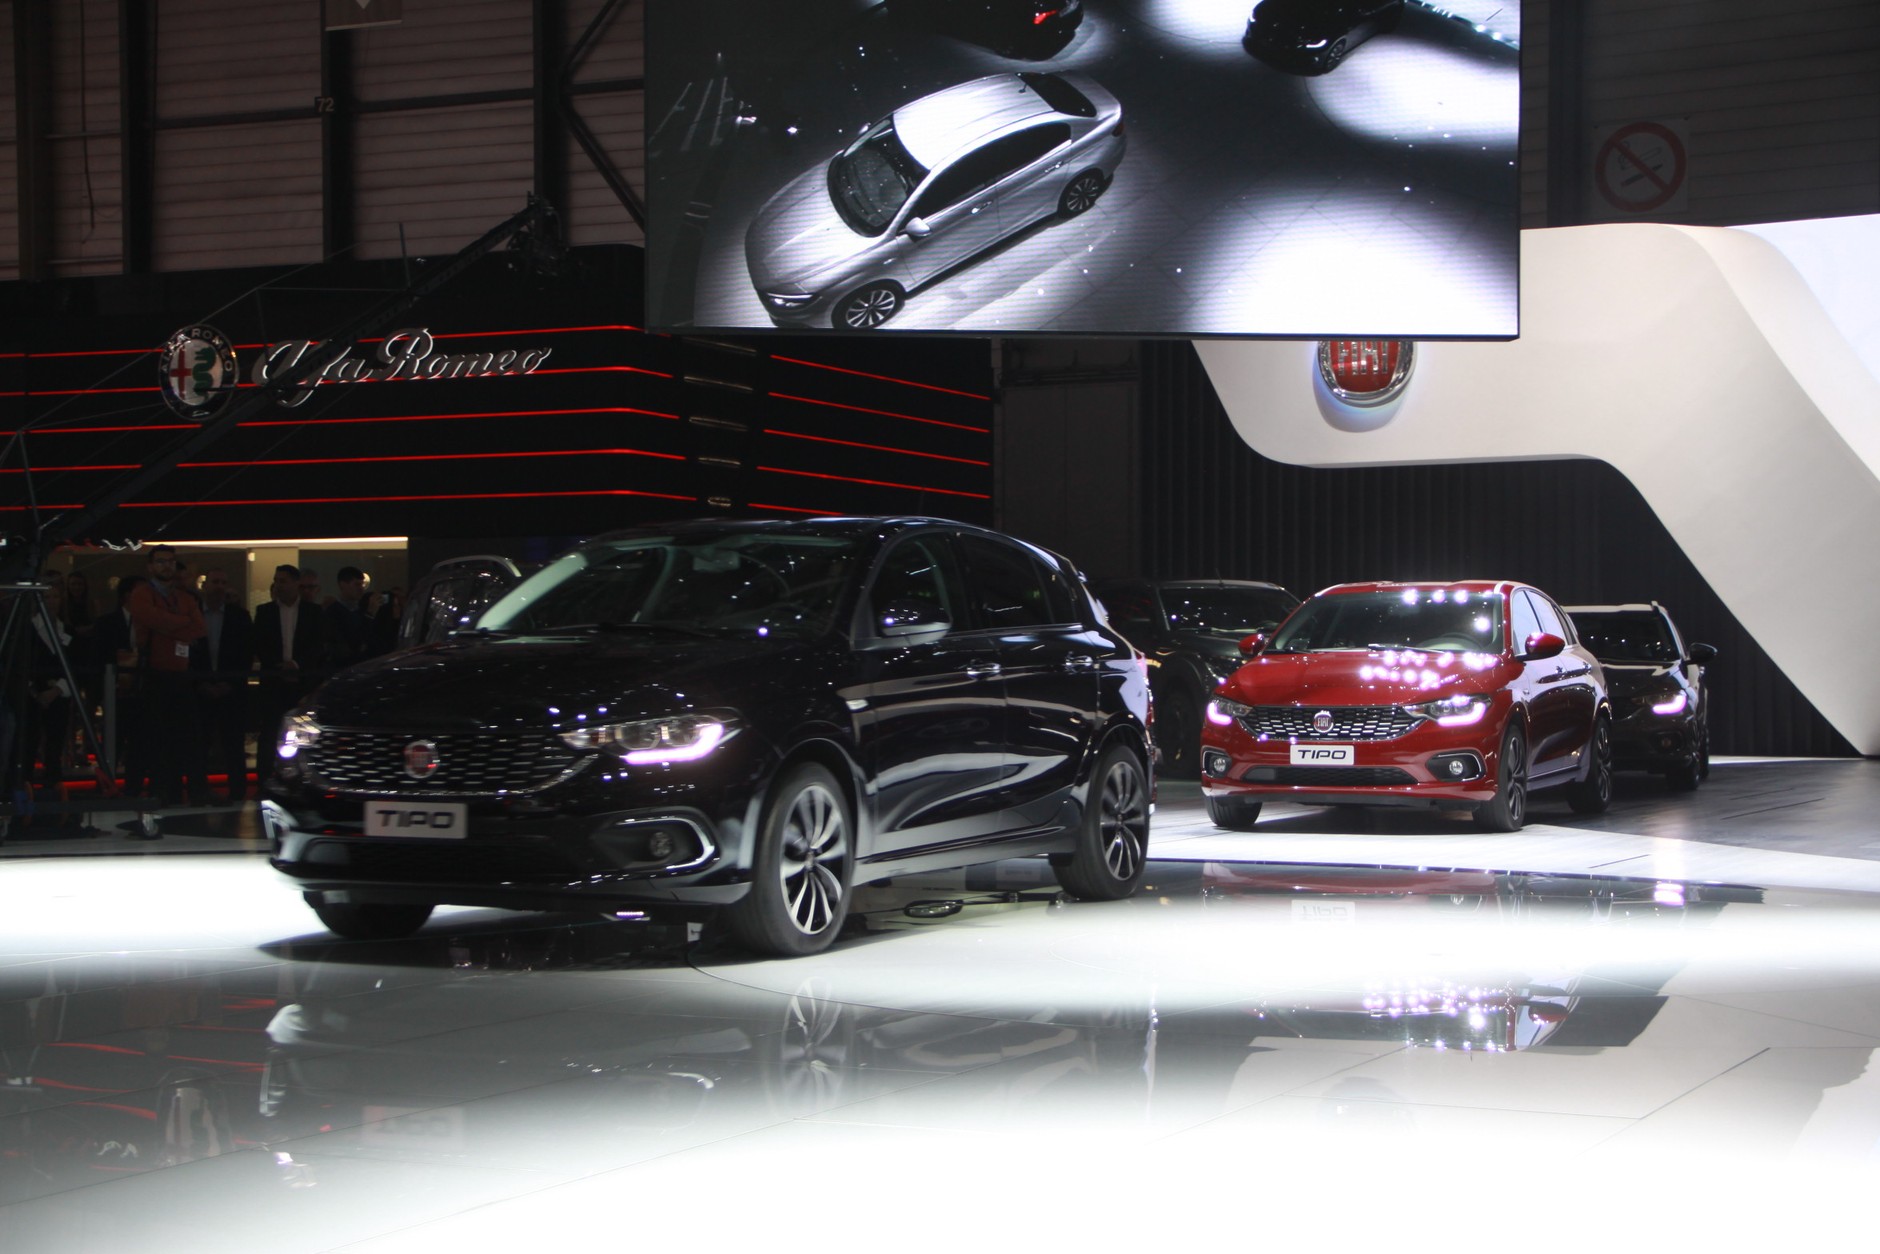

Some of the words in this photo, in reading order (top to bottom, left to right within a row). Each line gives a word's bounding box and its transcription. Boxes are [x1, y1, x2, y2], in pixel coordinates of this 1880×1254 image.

[316, 97, 335, 113] 72
[376, 327, 552, 381] Romeo
[1317, 717, 1329, 727] FIAT
[1297, 749, 1347, 760] TIPO
[375, 809, 455, 829] TIPO
